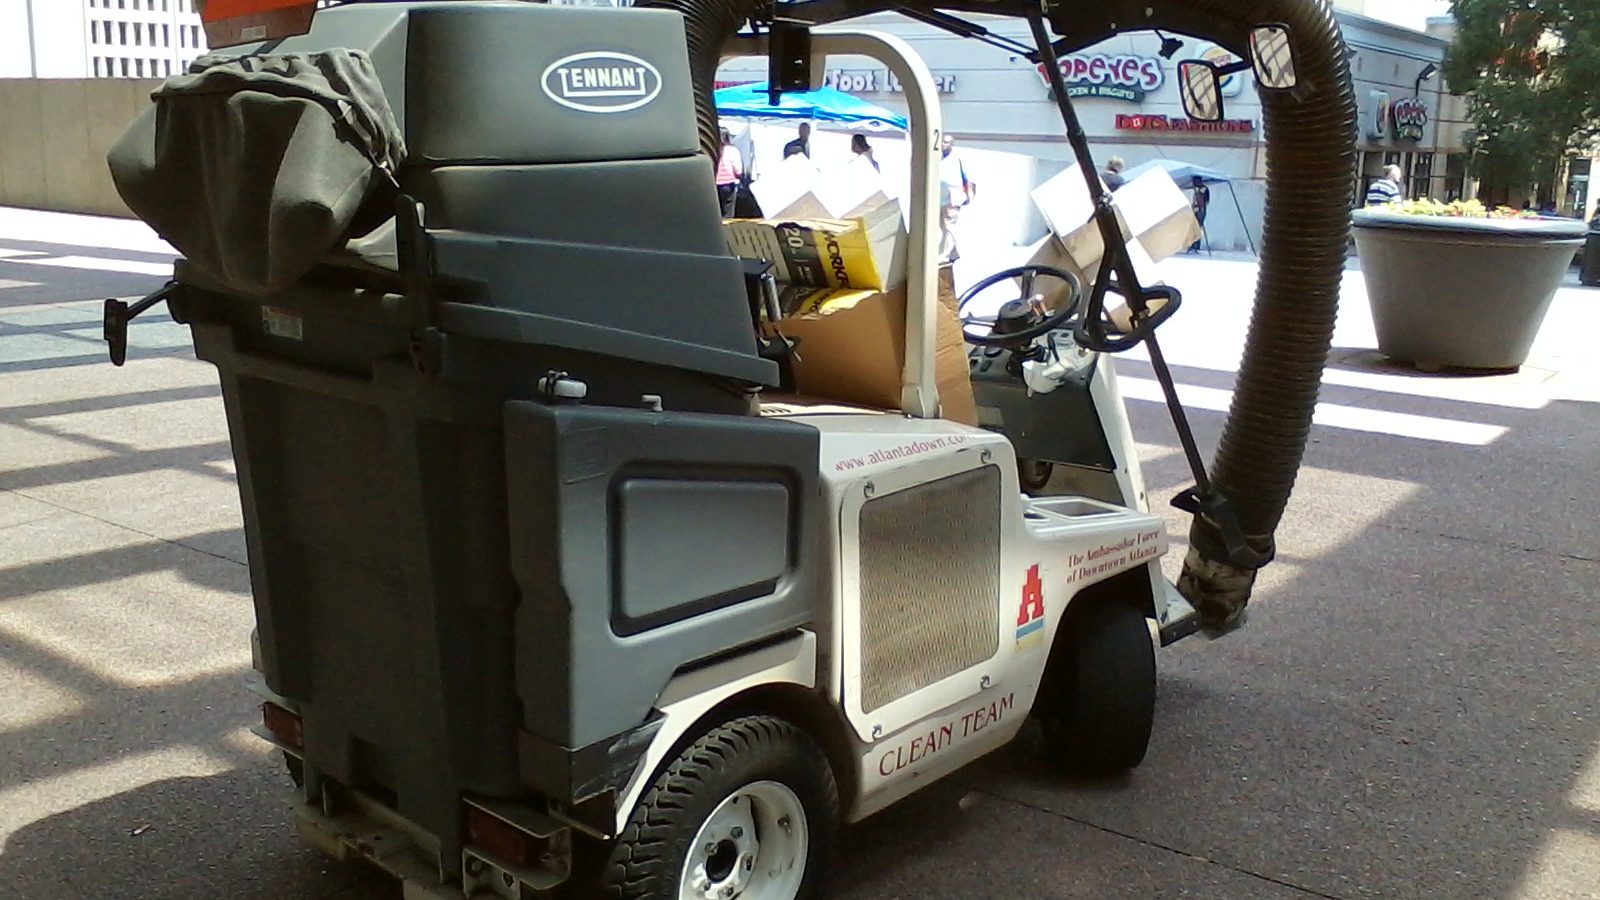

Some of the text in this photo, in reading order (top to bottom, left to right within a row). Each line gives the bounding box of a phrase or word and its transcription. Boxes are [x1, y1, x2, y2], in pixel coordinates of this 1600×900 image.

[556, 67, 647, 97] TENNANT
[933, 128, 940, 151] 2
[1066, 546, 1158, 583] of Downtown Atlanta
[1068, 554, 1084, 568] The
[879, 692, 1015, 777] CLEAN TEAM
